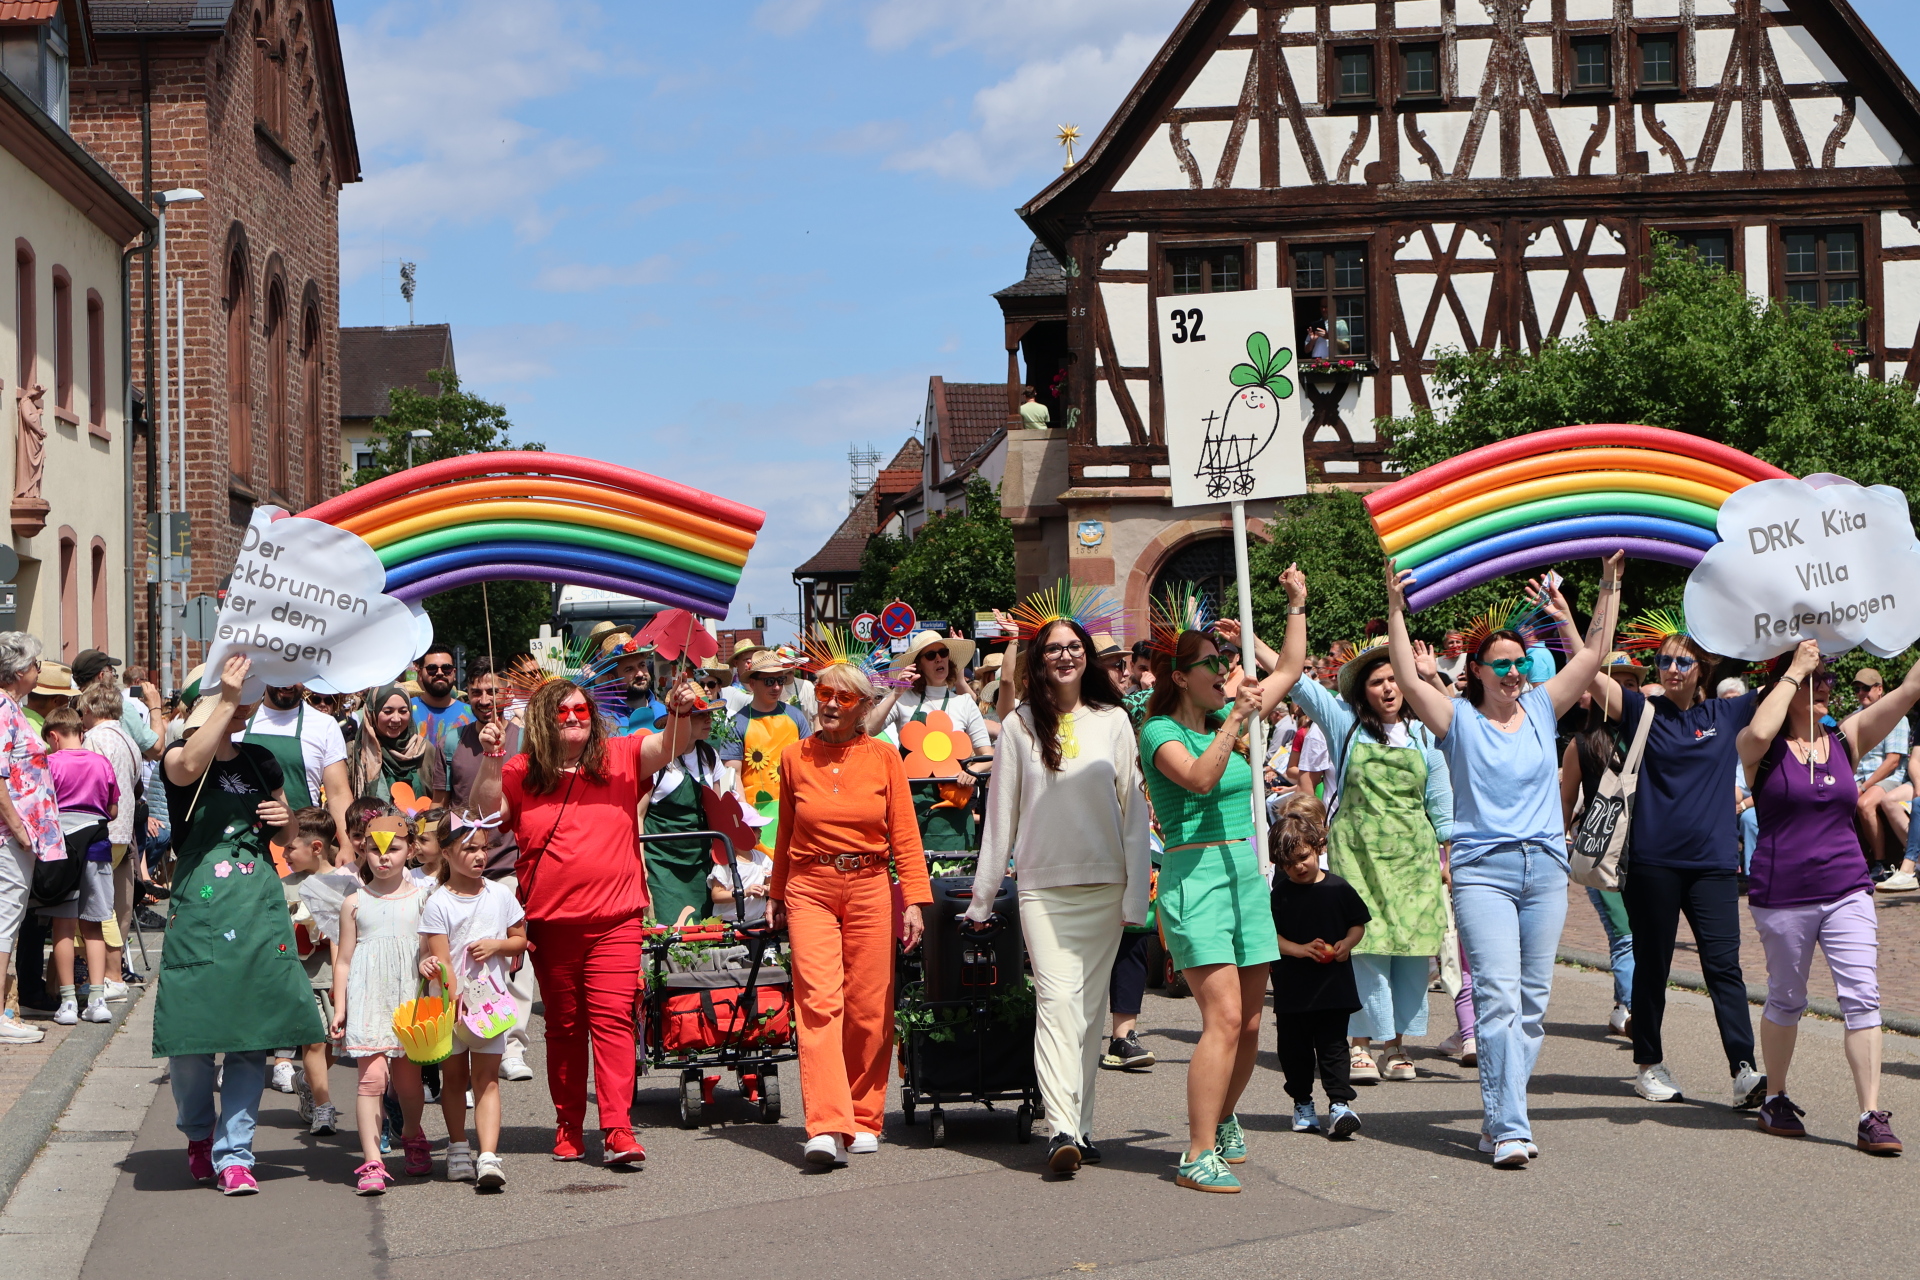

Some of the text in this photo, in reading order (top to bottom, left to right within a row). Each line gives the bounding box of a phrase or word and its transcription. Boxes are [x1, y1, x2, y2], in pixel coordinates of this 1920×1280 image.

[1170, 308, 1206, 344] 32
[241, 524, 285, 561] Der
[1748, 508, 1867, 555] DRK Kita
[1795, 561, 1849, 591] Villa
[271, 601, 327, 636] dem
[858, 621, 872, 635] 30
[1754, 594, 1896, 639] Regenbogen
[531, 641, 544, 651] 33
